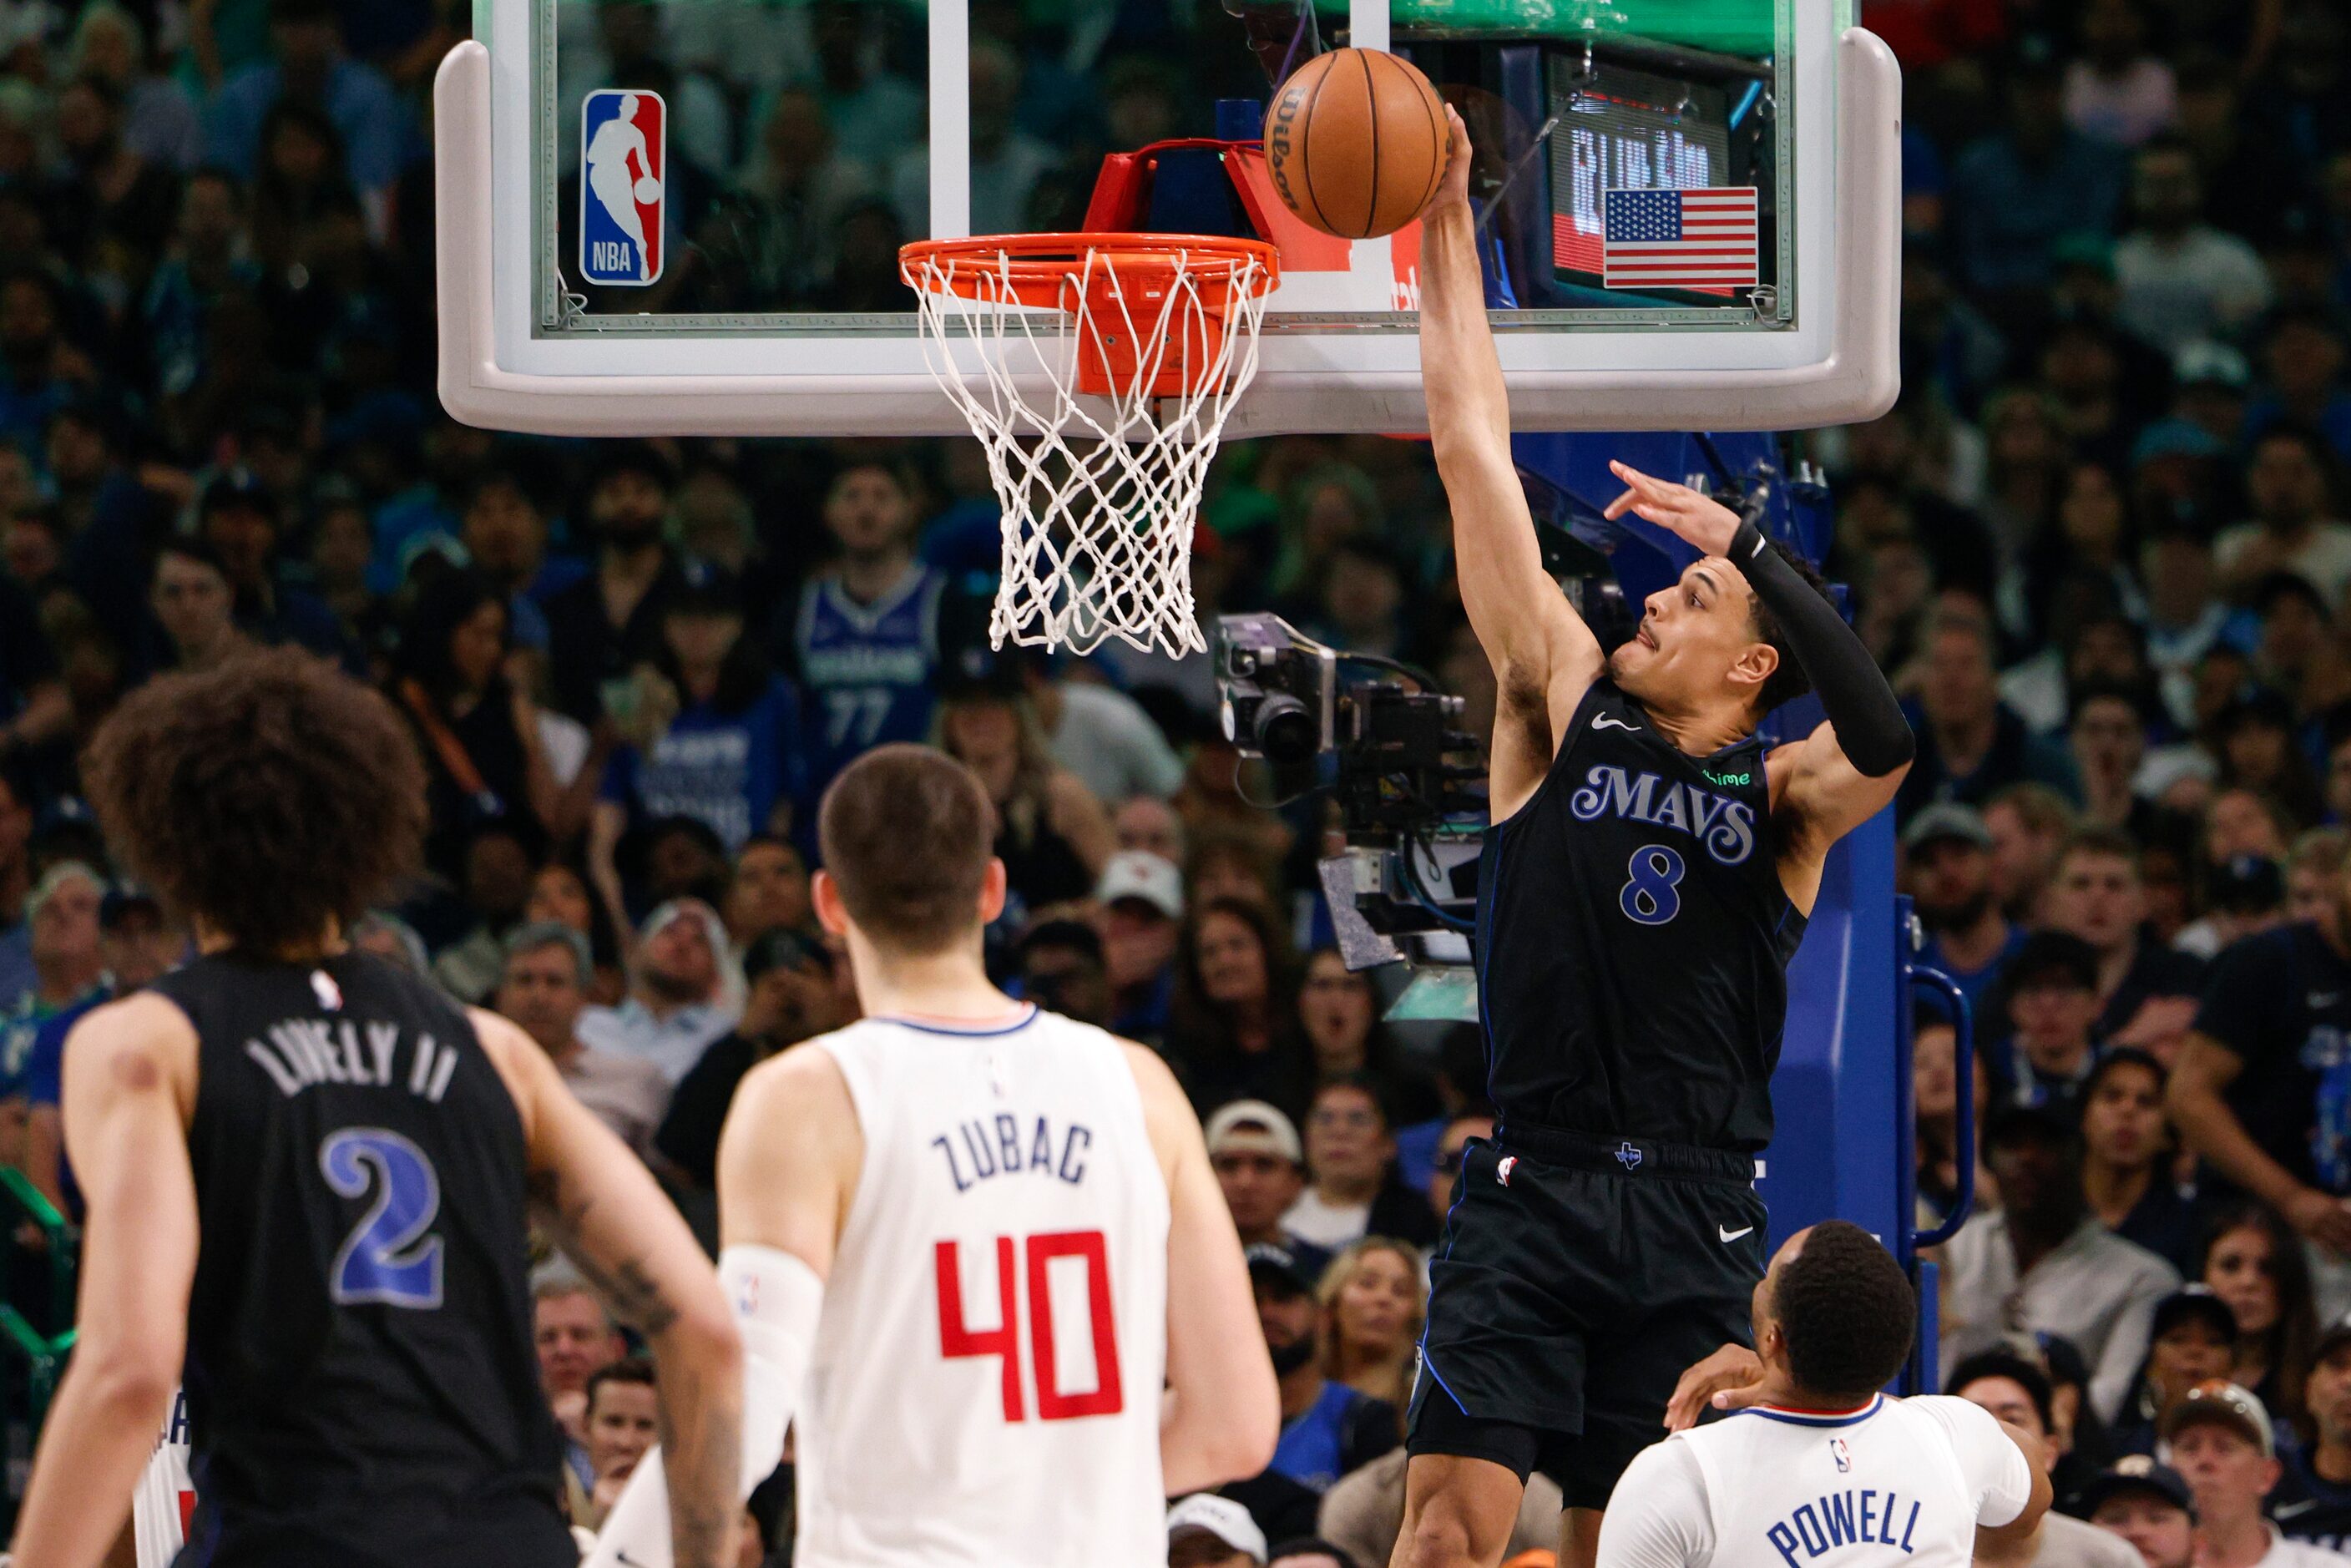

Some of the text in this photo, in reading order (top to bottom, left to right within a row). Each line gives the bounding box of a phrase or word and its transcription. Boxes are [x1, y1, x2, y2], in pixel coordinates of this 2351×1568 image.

[1272, 86, 1307, 210] Wilson
[593, 241, 632, 272] NBA
[827, 686, 894, 747] 77
[1570, 763, 1754, 865] MAVS
[1619, 843, 1686, 926] 8
[245, 1018, 458, 1103] LIVELY II
[932, 1113, 1092, 1192] ZUBAC
[318, 1127, 445, 1309] 2
[934, 1231, 1124, 1423] 40
[1766, 1490, 1921, 1568] POWELL
